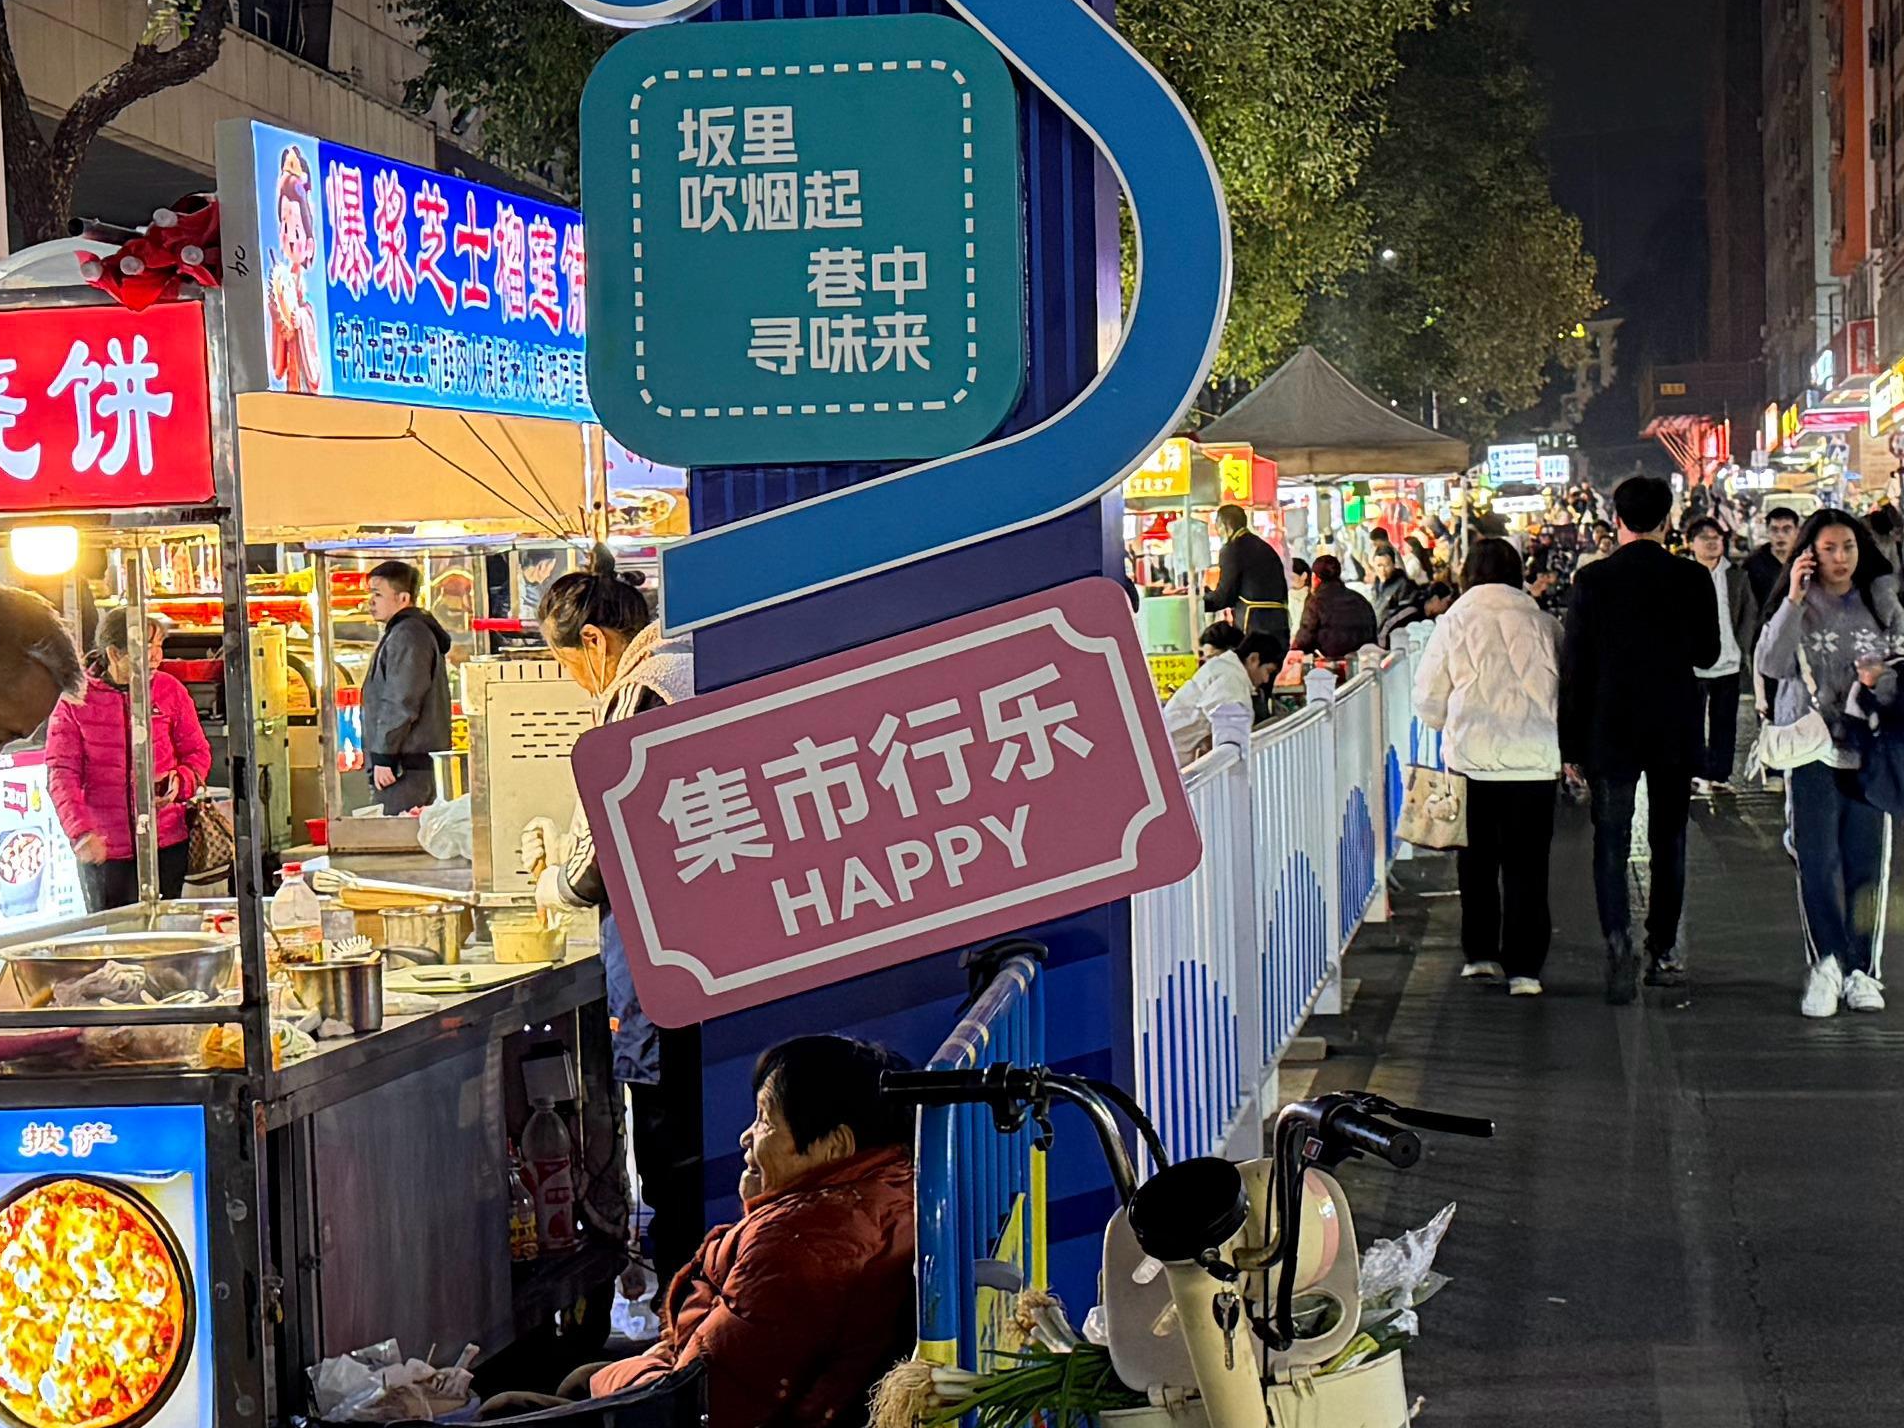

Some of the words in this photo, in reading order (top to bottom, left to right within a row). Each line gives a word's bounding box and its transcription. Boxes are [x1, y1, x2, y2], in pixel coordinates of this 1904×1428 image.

[679, 105, 798, 166] 坂里
[680, 170, 863, 233] 吹烟起
[807, 247, 928, 309] 巷中
[747, 312, 930, 375] 寻味来
[658, 662, 1095, 885] 集市行乐
[771, 804, 1031, 936] HAPPY
[19, 1121, 118, 1158] 披萨
